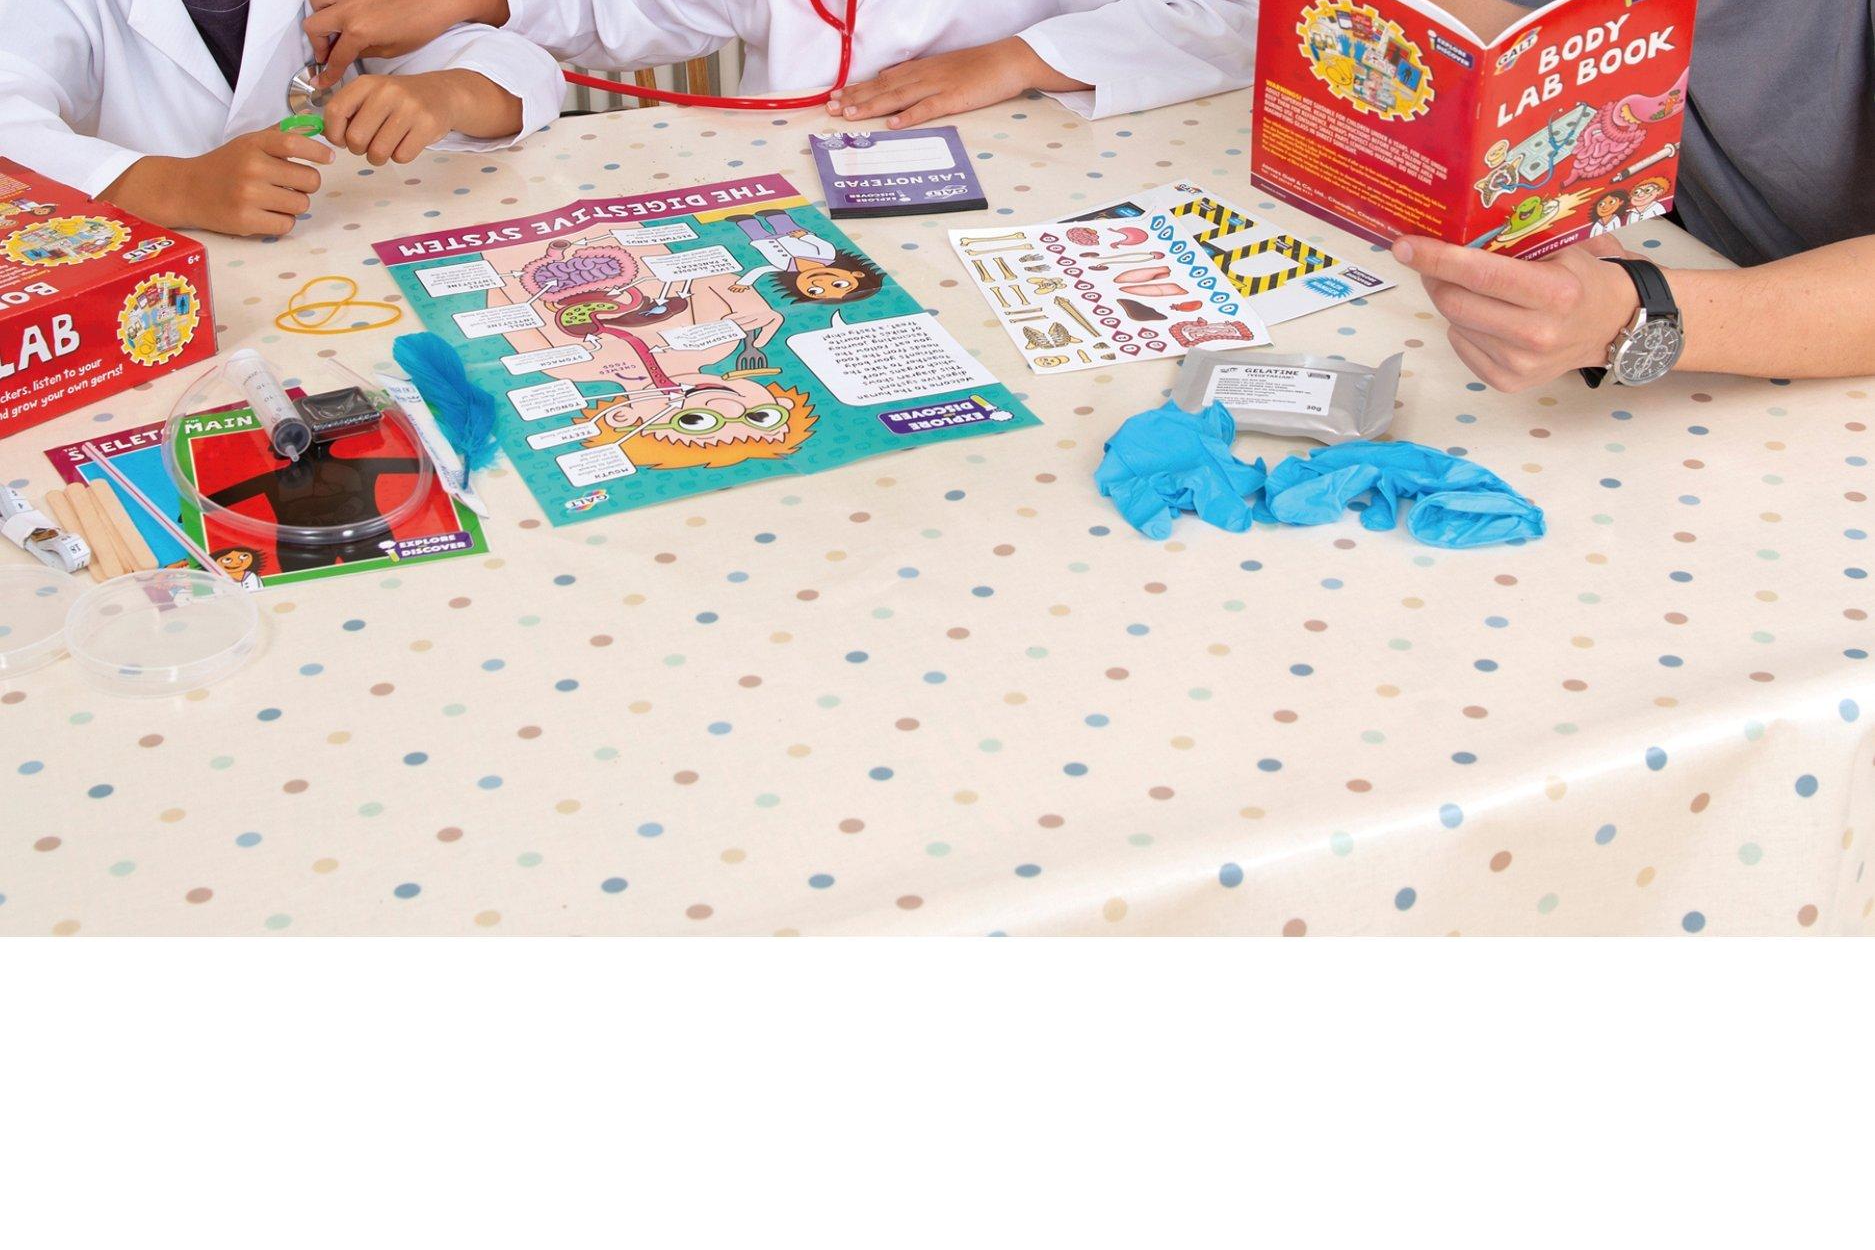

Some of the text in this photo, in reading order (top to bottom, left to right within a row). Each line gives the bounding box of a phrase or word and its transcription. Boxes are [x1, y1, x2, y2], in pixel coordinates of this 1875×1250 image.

[1436, 35, 1467, 57] EXPLORE
[1498, 38, 1537, 66] GALT
[1538, 13, 1631, 75] BODY
[1436, 43, 1470, 67] DISCOVER
[1497, 25, 1676, 127] LAB BOOK
[834, 172, 966, 188] LAB NOTEPAD
[849, 191, 895, 199] DISCOVER
[399, 182, 775, 259] THE DIGESTIVE SYSTEM
[129, 240, 174, 258] GALT
[1522, 241, 1559, 261] IENTIFIC
[187, 255, 200, 265] 6+
[0, 282, 59, 309] BO
[826, 334, 877, 344] favourite
[827, 332, 928, 350] fascinating journey
[540, 355, 583, 367] STOMACH
[898, 349, 943, 357] nutrients
[904, 354, 949, 363] together
[33, 373, 62, 391] listen
[63, 369, 76, 379] to
[78, 358, 103, 376] your
[888, 364, 925, 374] organs
[895, 369, 937, 379] diagram
[919, 370, 967, 381] digestive
[1245, 368, 1300, 376] GELATINE
[929, 377, 974, 387] Welcome
[11, 363, 123, 418] grow your own germs!
[857, 391, 890, 399] human
[545, 402, 581, 413] TONGUE
[889, 402, 974, 422] DISCOVER
[184, 415, 253, 434] MAIN
[909, 412, 985, 431] EXPLORE
[561, 430, 592, 441] TEETH
[68, 427, 168, 461] SELET
[594, 468, 629, 479] MOUTH
[571, 494, 608, 507] GALT
[399, 534, 456, 548] EXPLORE
[401, 541, 466, 557] DISCOVER
